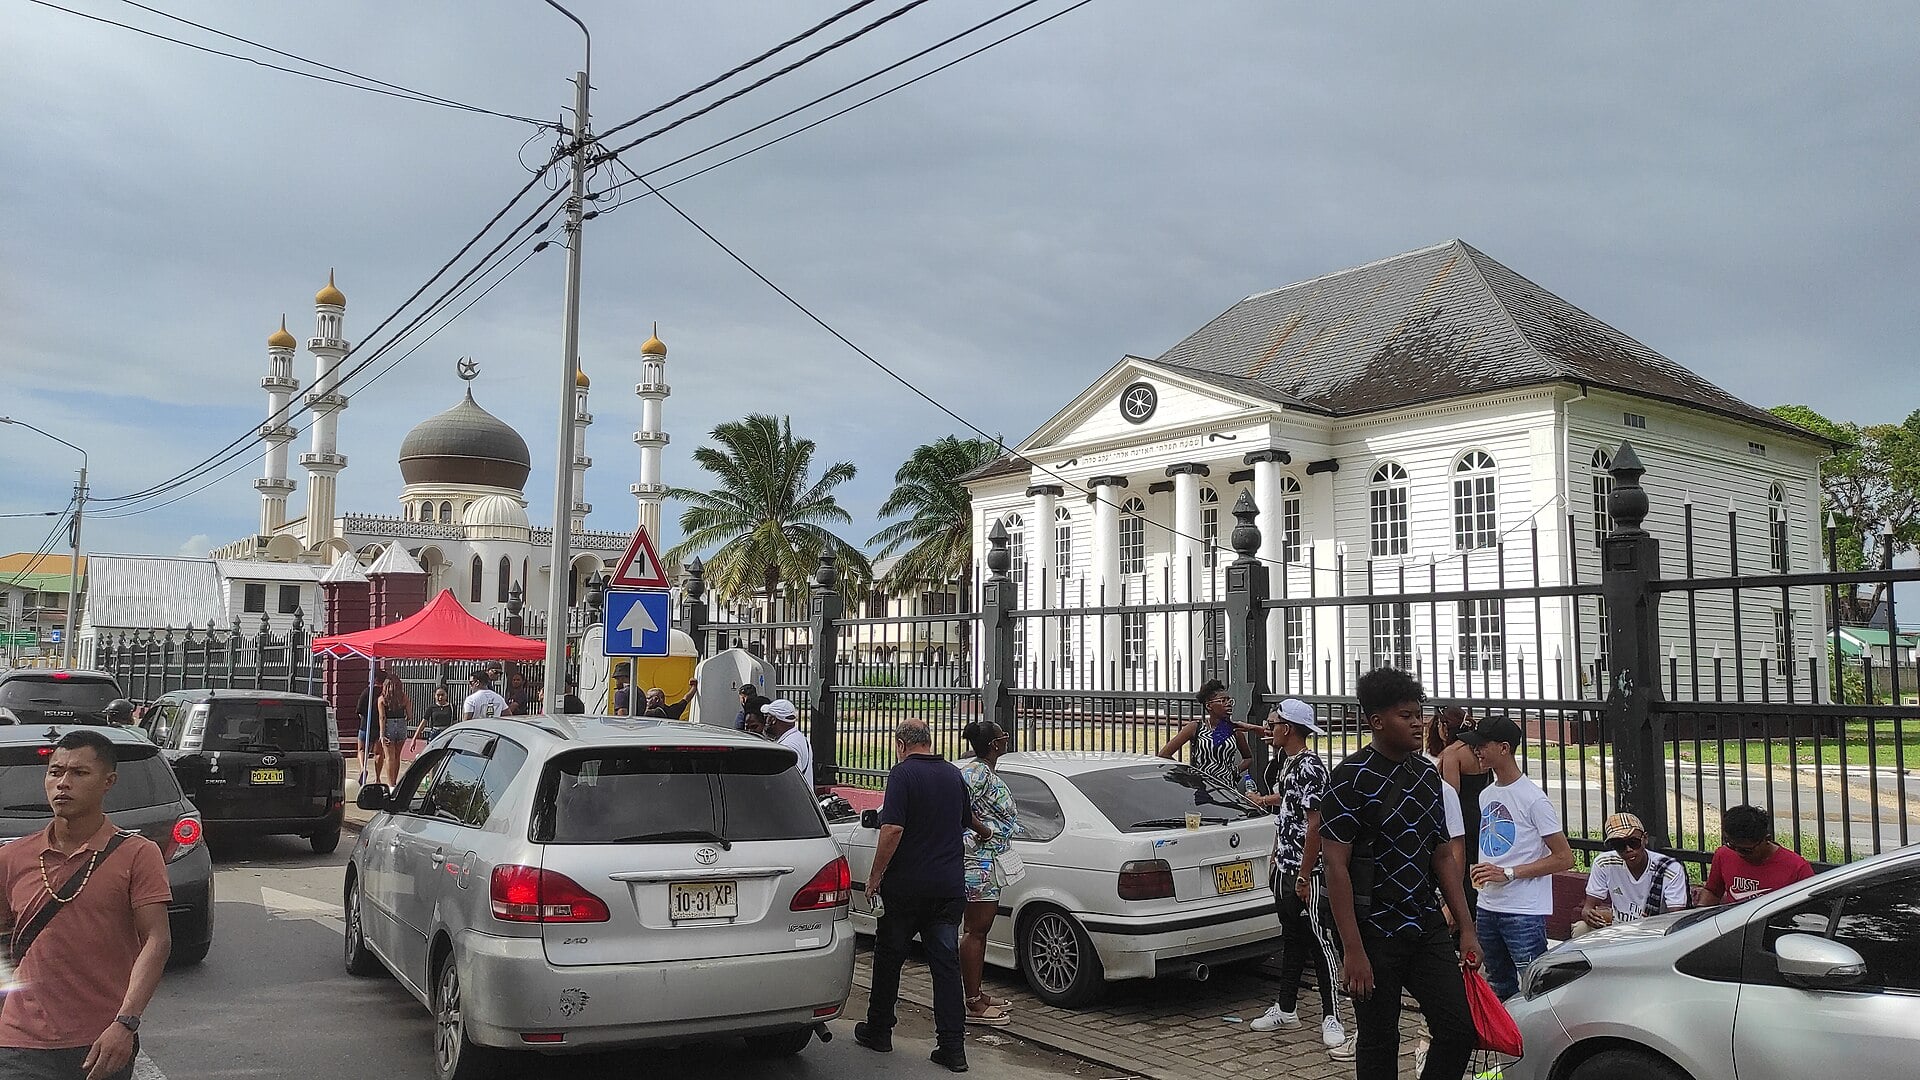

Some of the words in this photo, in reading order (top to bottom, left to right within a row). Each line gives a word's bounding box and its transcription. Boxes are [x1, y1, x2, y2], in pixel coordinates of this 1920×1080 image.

[1731, 876, 1760, 892] JUST
[675, 892, 711, 912] 10-31
[714, 885, 732, 904] XP
